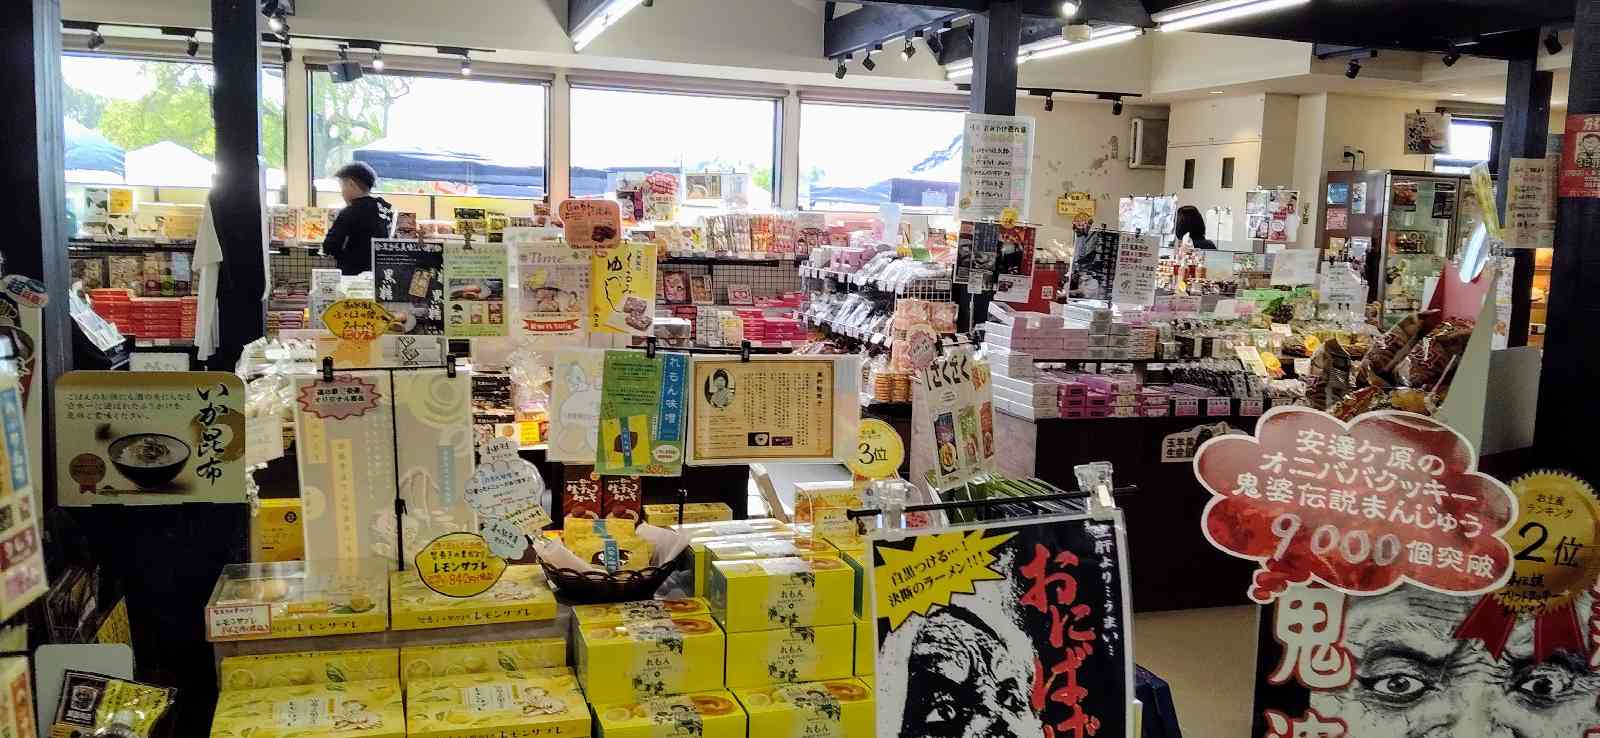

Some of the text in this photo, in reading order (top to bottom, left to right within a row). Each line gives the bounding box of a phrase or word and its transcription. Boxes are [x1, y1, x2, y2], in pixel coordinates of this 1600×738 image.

[196, 383, 230, 487] いか昆布
[1260, 451, 1478, 504] オニババクッキー
[1536, 494, 1567, 506] お土産
[1231, 471, 1484, 538] 鬼婆伝説まんじゅう
[1528, 503, 1576, 519] ランキング
[1270, 512, 1496, 580] 9000 個突破
[645, 657, 671, 667] れもん
